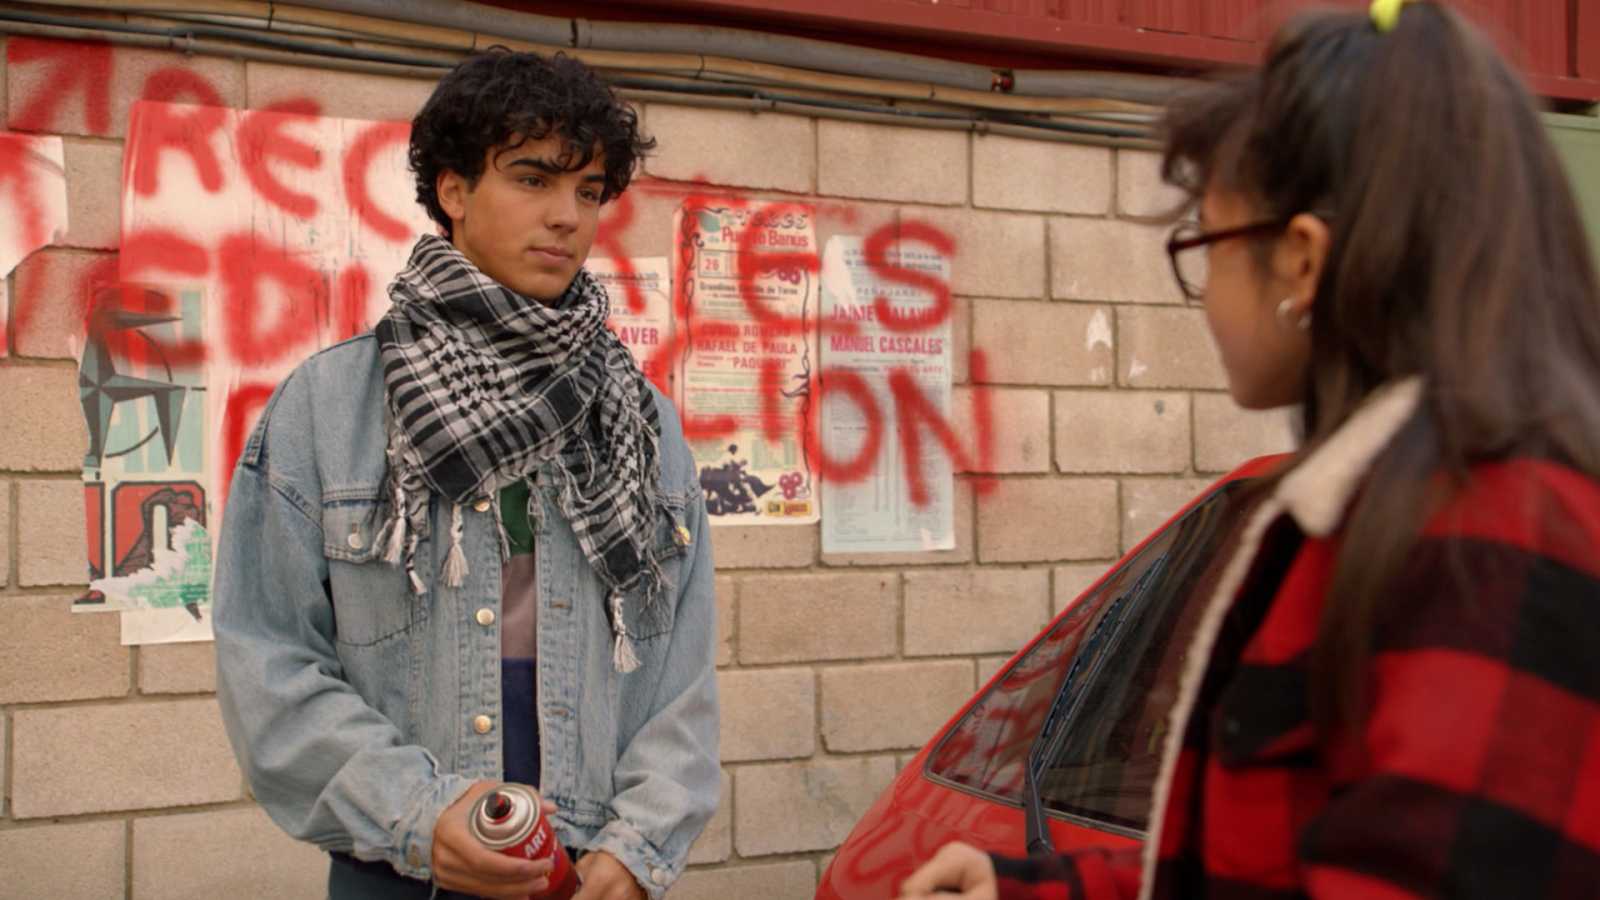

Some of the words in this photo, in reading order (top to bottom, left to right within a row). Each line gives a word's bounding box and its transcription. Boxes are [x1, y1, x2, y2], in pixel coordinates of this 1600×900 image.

[619, 327, 659, 345] AVER
[743, 341, 757, 353] DE
[879, 336, 943, 355] CASCALES
